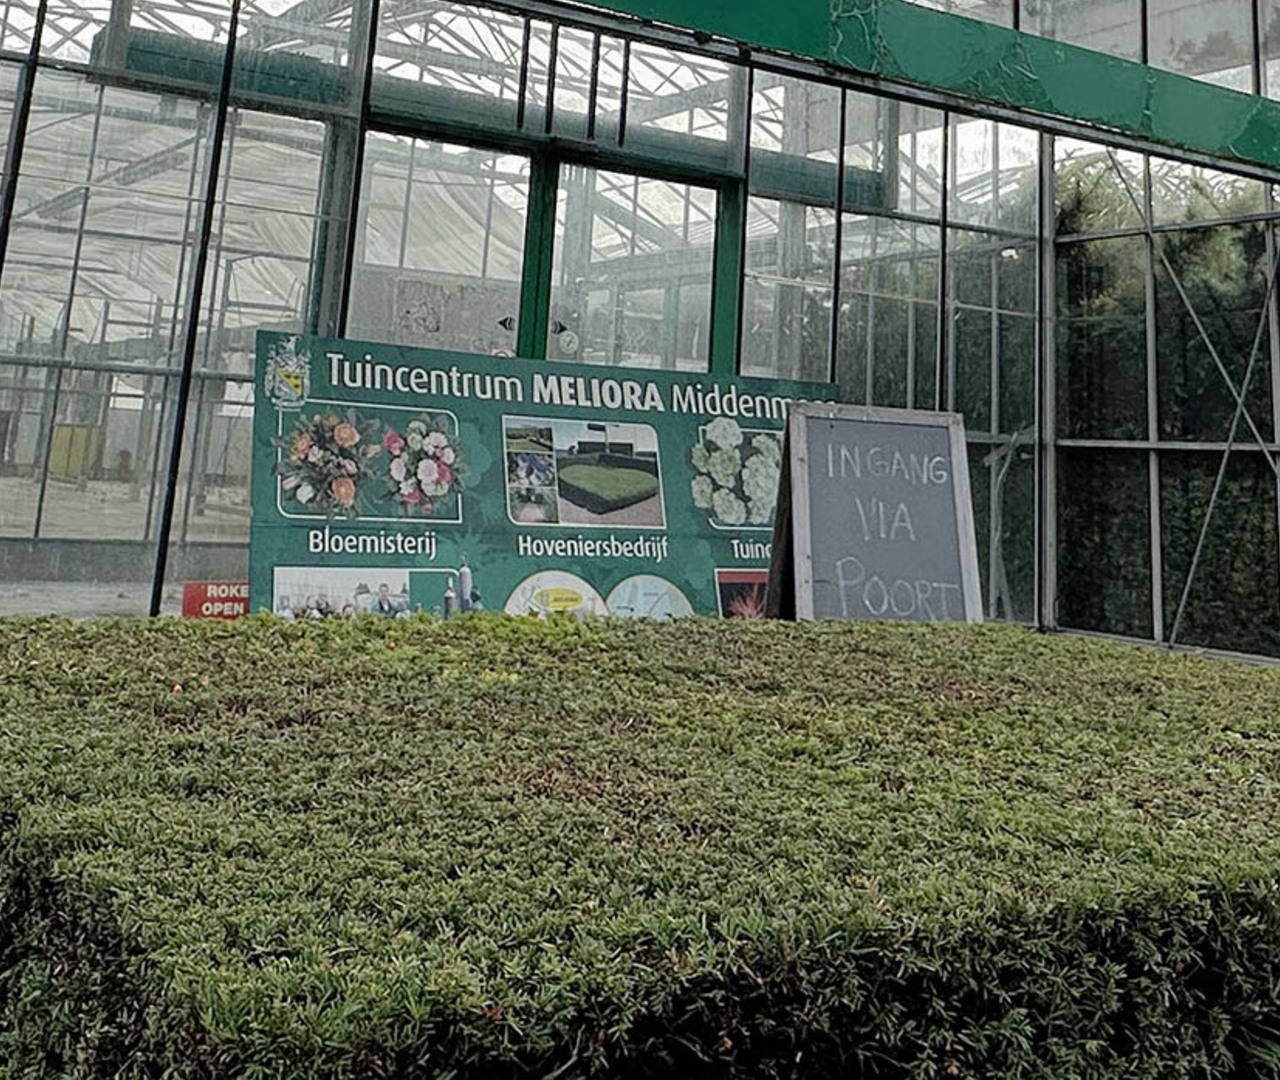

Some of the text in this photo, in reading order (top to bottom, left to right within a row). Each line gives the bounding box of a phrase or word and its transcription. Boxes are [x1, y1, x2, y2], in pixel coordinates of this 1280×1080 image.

[326, 353, 838, 420] Tuincentrum MELIORA Middenm
[827, 443, 948, 485] INGANG
[856, 497, 916, 541] VIA
[308, 526, 438, 561] Bloemisterij
[518, 535, 669, 563] Hoveniersbedrijf
[201, 602, 245, 616] OPEN
[836, 556, 959, 620] POORT
